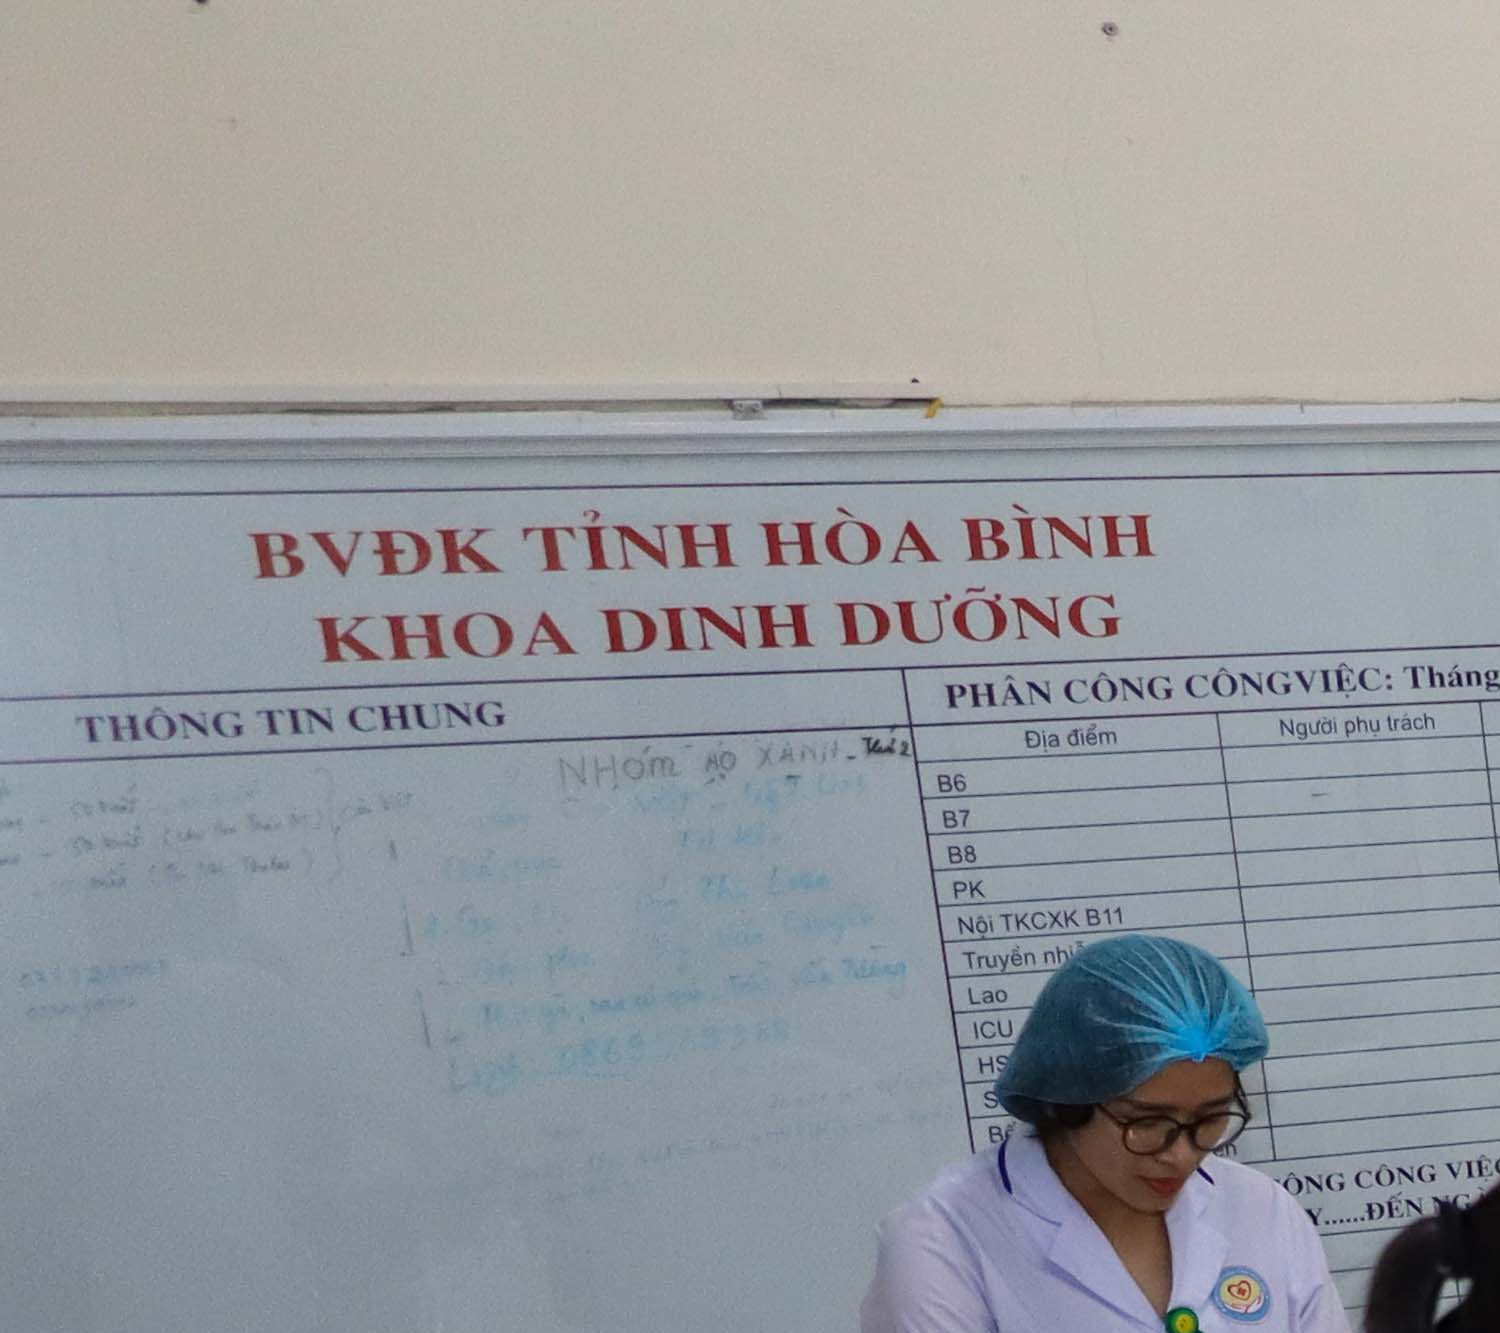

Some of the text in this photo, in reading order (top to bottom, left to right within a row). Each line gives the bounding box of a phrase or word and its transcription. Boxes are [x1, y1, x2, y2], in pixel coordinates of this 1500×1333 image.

[247, 503, 1157, 579] BVĐK TỈNH HÒA BÌNH
[313, 585, 1122, 663] KHOA DINH DƯỠNG
[945, 675, 1052, 709] PHÂN
[1063, 671, 1173, 704] CÔNG
[75, 701, 507, 743] THÔNG TIN CHUNG
[1279, 713, 1436, 739] Người phụ trách
[1024, 724, 1118, 752] Địa điểm
[937, 774, 967, 793] B6
[942, 809, 971, 829] B7
[947, 845, 977, 864] B8
[953, 880, 986, 900] PK
[957, 906, 1124, 938] Nội TKCXK B11
[962, 945, 1036, 973] Truyền
[968, 987, 1008, 1005] Lao
[973, 1019, 1013, 1040] ICU
[978, 1055, 1009, 1074] HS
[1274, 1171, 1346, 1196] ÔNG
[1354, 1163, 1437, 1189] CÔNG
